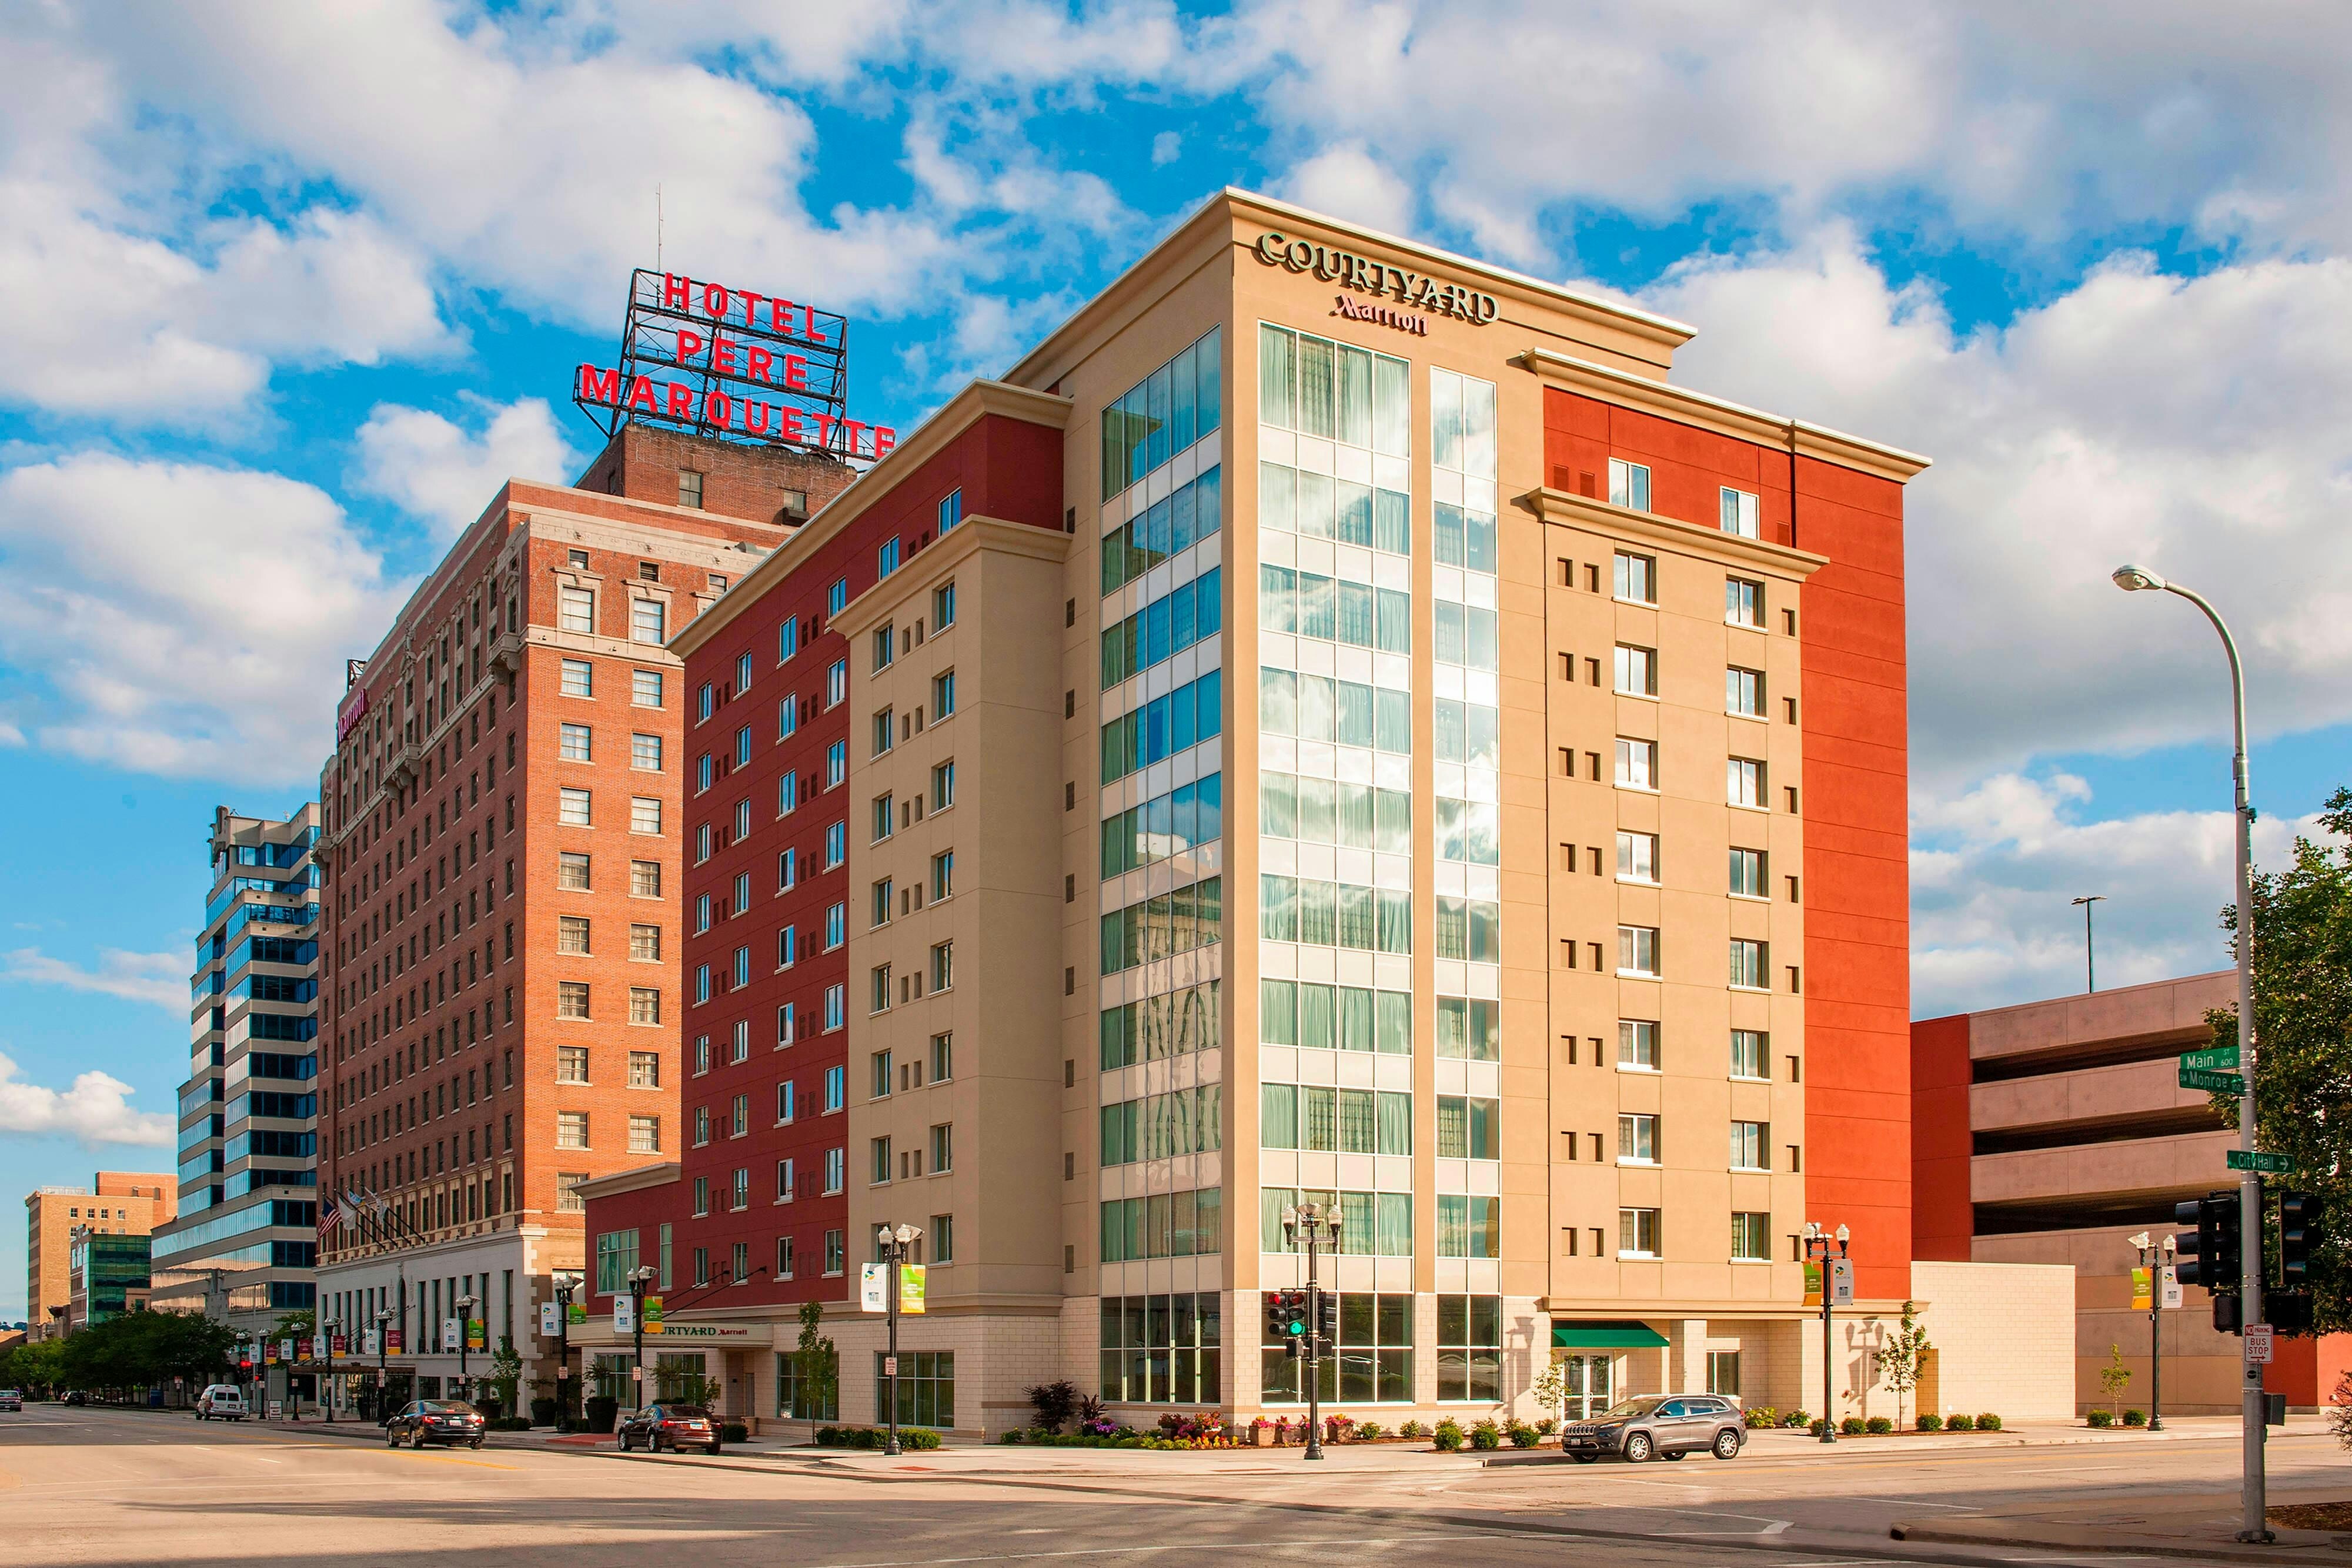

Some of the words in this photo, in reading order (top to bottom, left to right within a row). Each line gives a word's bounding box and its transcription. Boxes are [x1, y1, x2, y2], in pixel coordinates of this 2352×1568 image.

[1261, 231, 1501, 323] COURTYARD
[664, 272, 826, 342] HOTEL
[1334, 293, 1429, 335] Marriott
[676, 329, 807, 390] PERE
[581, 362, 896, 459] MARQUETTE
[2187, 1054, 2214, 1069] Main
[2220, 1058, 2233, 1066] 600
[2189, 1071, 2227, 1088] Monroe
[2238, 1153, 2256, 1170] City
[2257, 1154, 2274, 1169] Hall
[642, 1326, 717, 1336] URTYARD
[2246, 1326, 2253, 1335] NO
[2248, 1346, 2269, 1355] STOP
[2250, 1338, 2266, 1346] BUS
